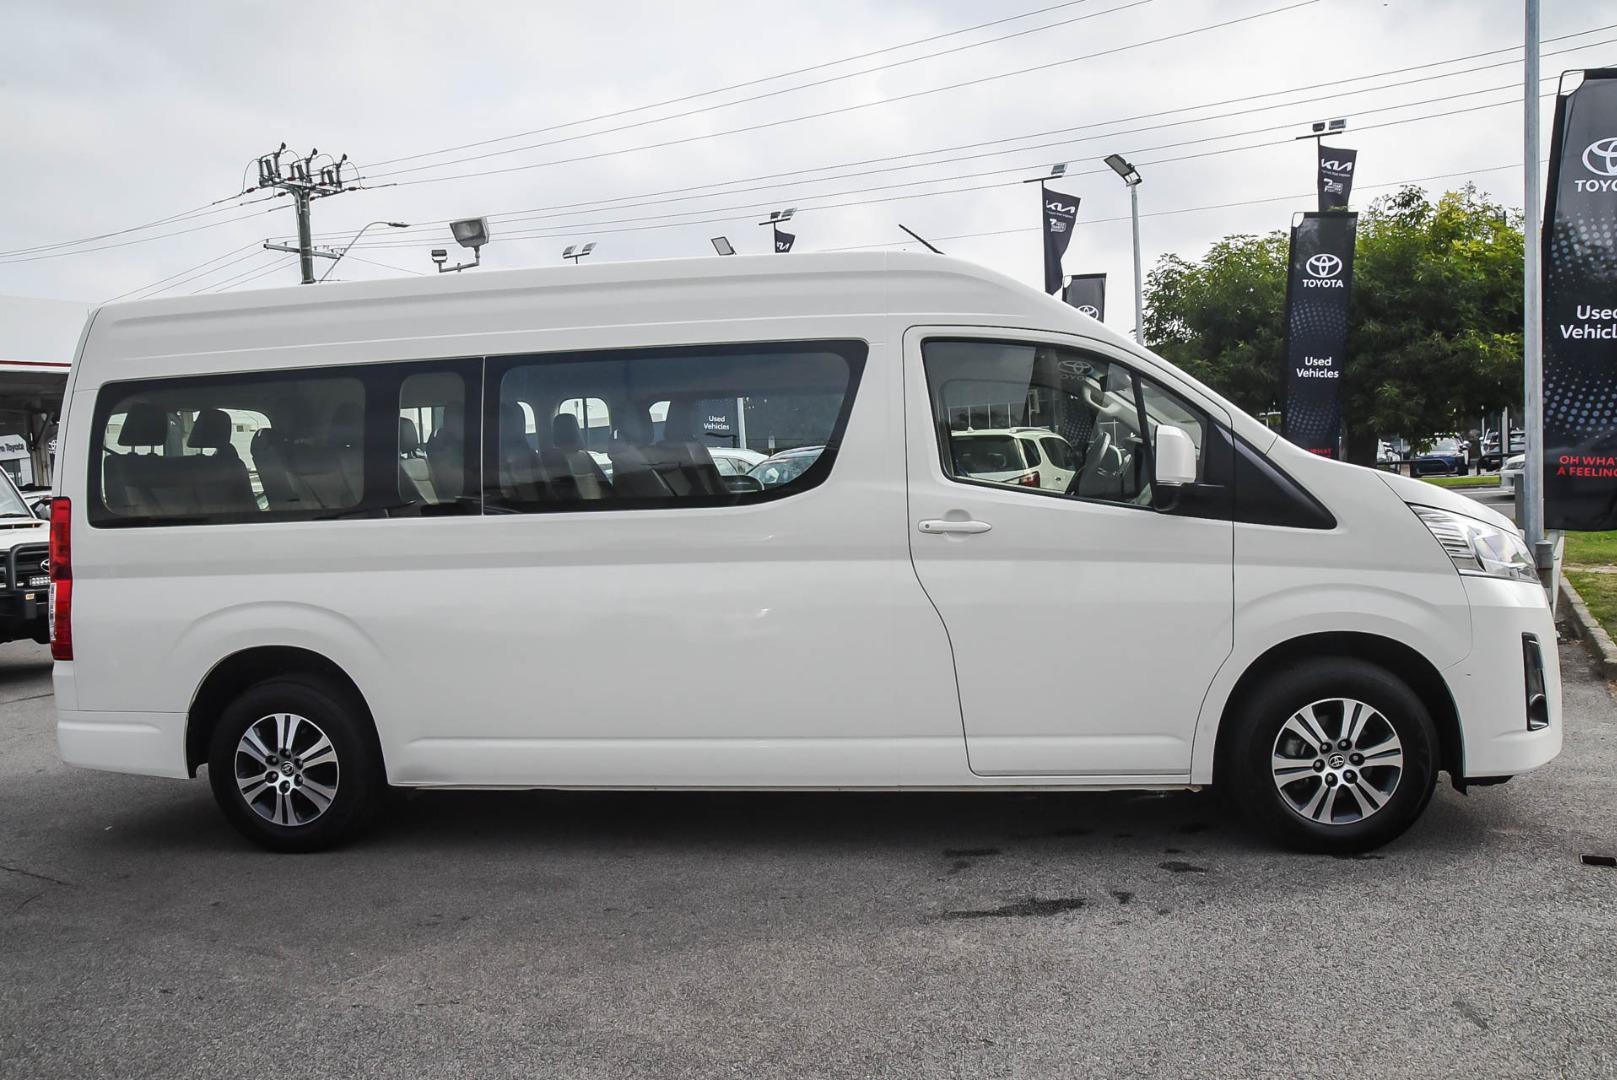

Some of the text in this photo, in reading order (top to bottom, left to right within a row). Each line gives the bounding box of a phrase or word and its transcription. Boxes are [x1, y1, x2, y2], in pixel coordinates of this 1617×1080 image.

[1302, 279, 1344, 288] TOYOTA
[1304, 356, 1332, 366] Used
[1296, 368, 1339, 378] Vehicles
[703, 422, 730, 430] Vehicles
[1560, 455, 1580, 465] OH
[1556, 466, 1567, 476] A
